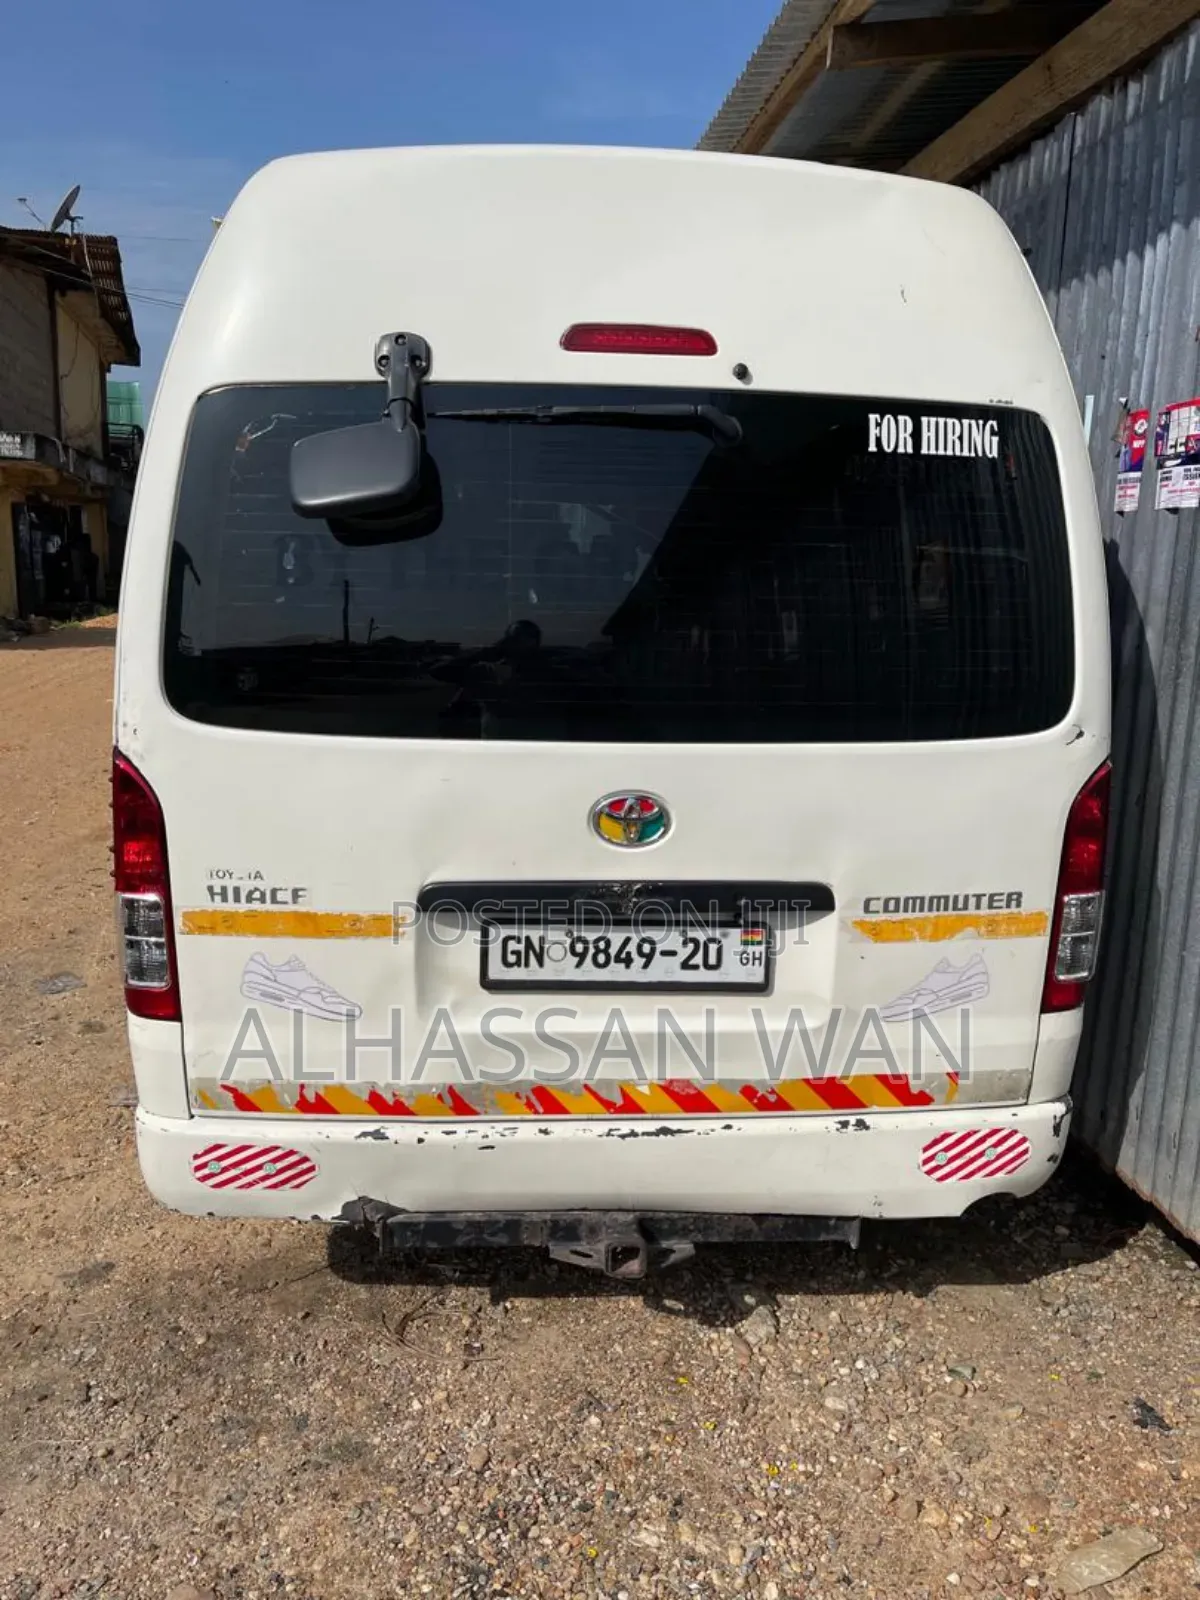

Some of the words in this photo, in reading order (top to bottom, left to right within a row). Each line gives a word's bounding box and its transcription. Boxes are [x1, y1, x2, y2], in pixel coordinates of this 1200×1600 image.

[868, 413, 914, 454] FOR
[920, 416, 999, 458] HIRING
[863, 891, 1023, 914] COMMUTER
[568, 936, 723, 971] 9849-20
[739, 951, 763, 967] GH
